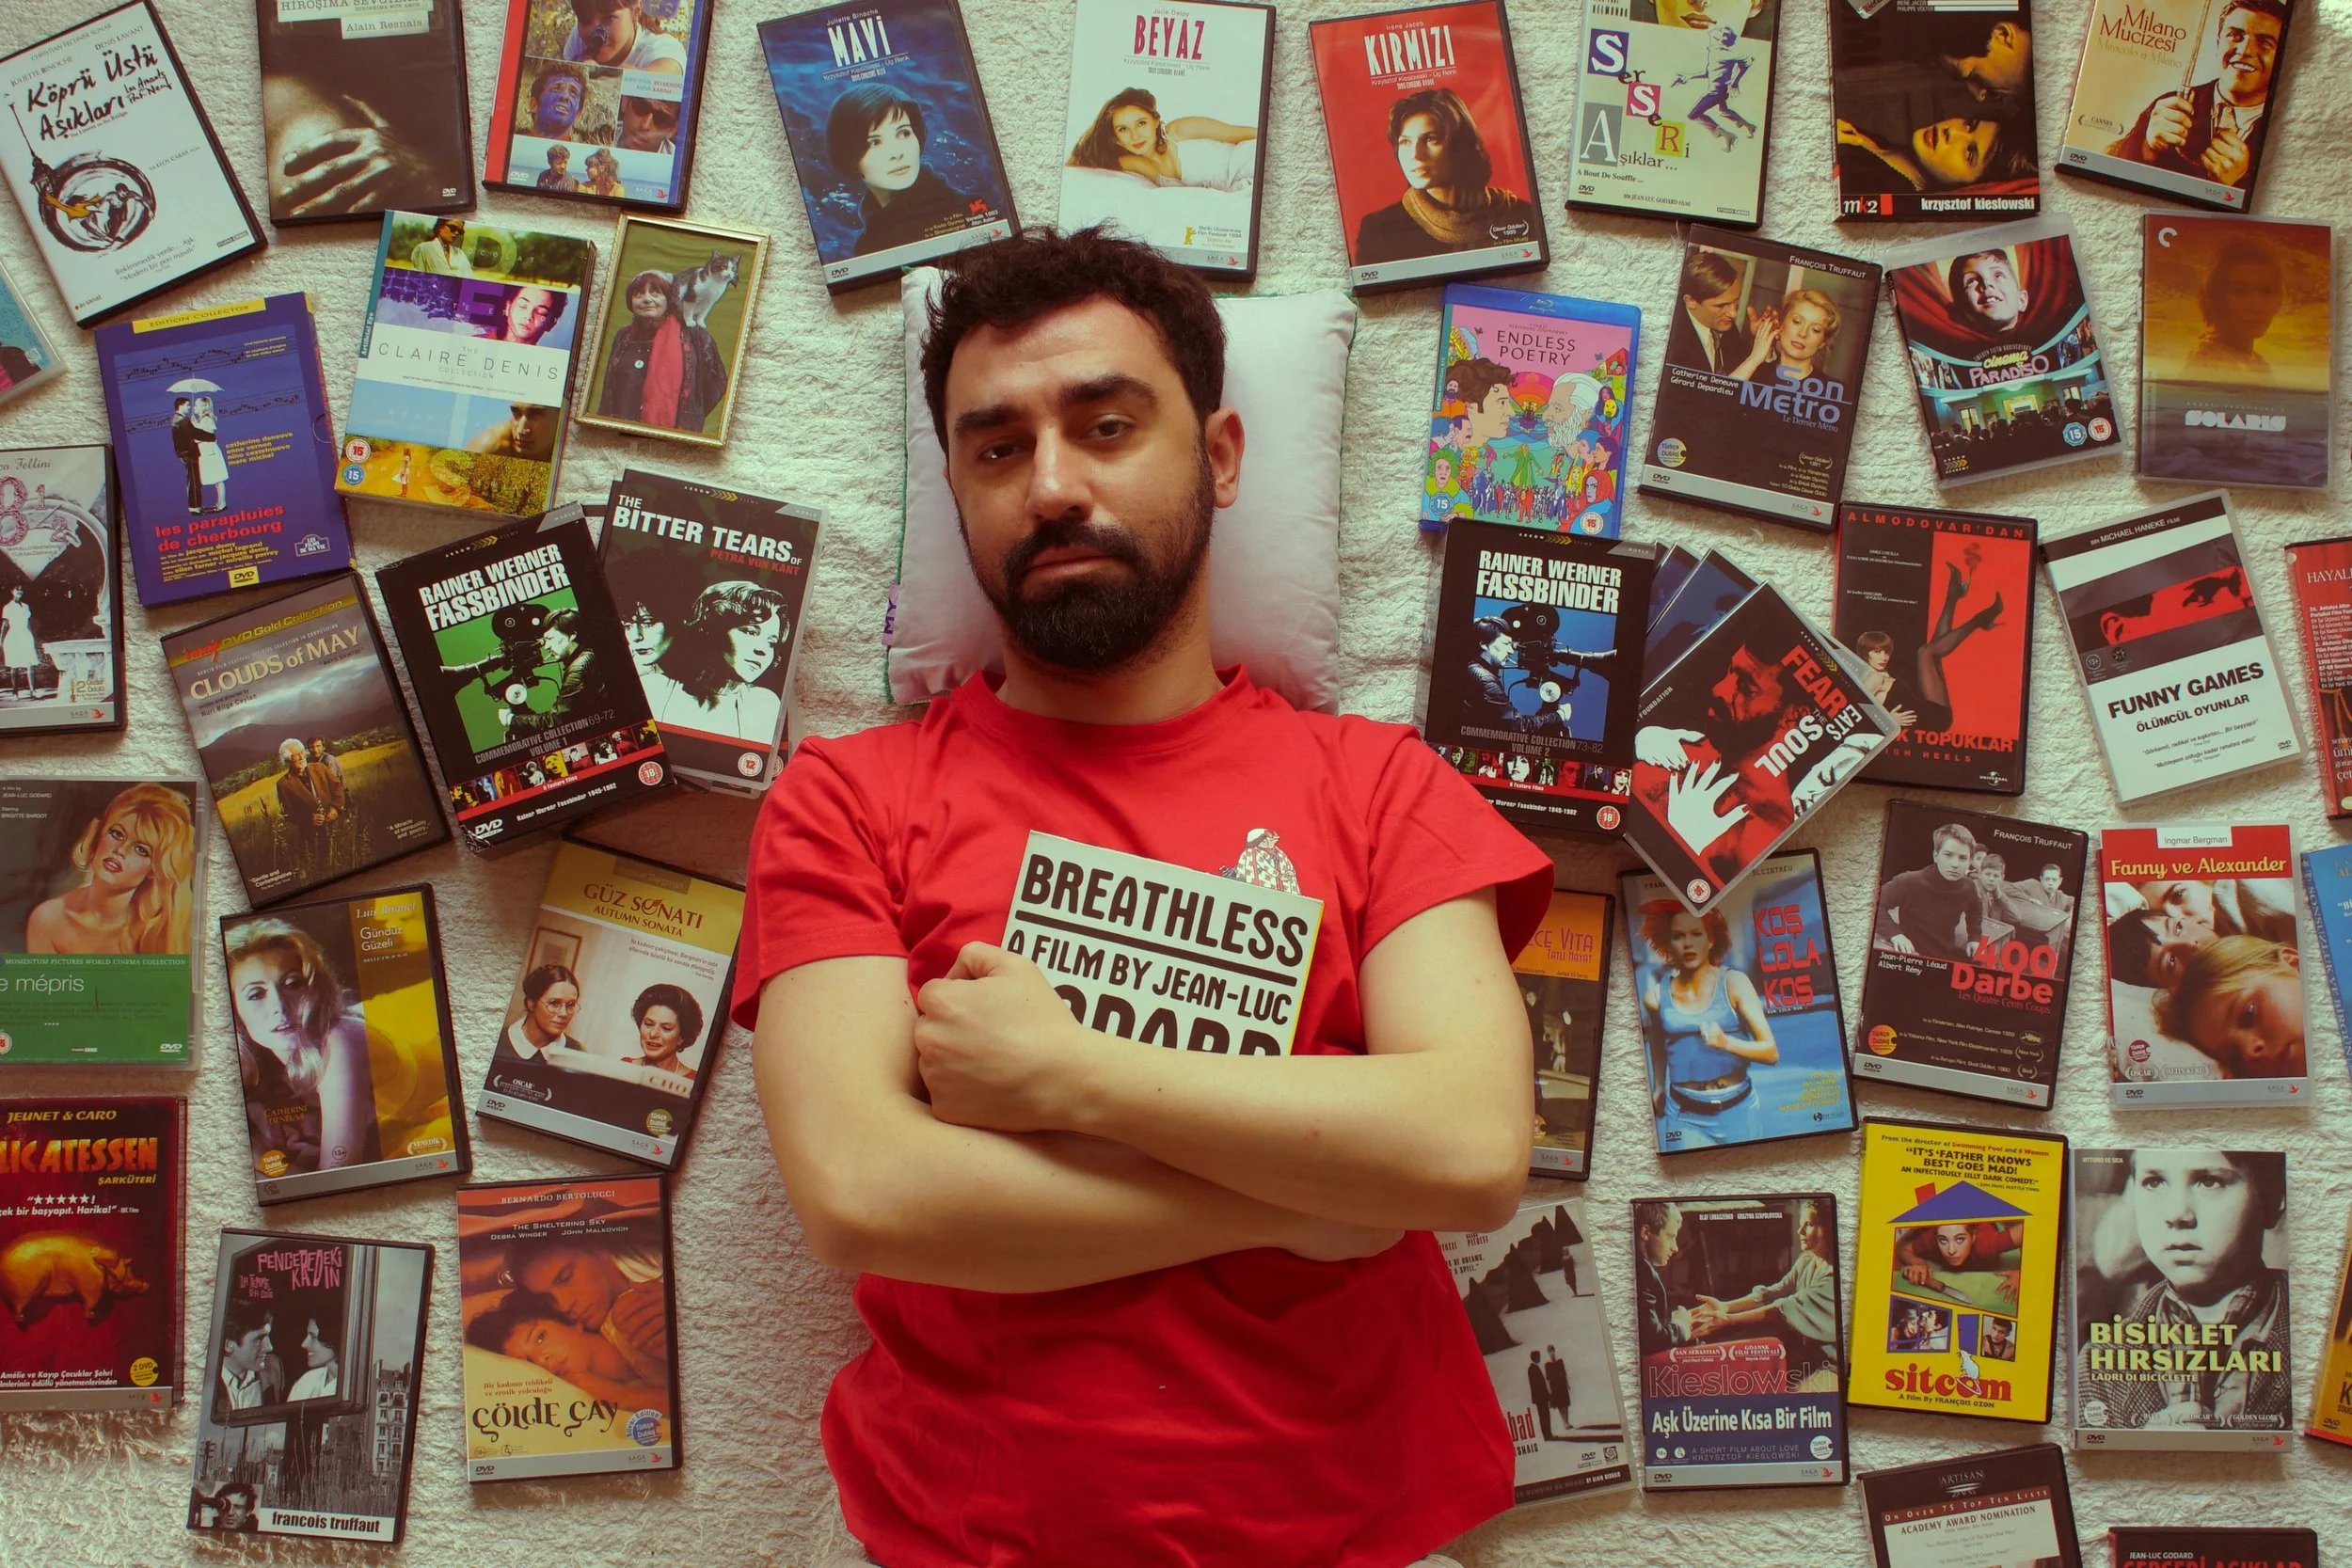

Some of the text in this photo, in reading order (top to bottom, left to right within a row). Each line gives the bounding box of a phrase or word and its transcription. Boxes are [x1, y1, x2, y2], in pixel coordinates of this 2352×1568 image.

[345, 18, 422, 33] Alain Resnais
[826, 14, 850, 26] Juliette
[2122, 5, 2187, 41] Milano
[1134, 15, 1205, 61] BEYAZ
[2099, 14, 2176, 53] Mucizesi
[1364, 24, 1455, 76] KIRMIZI
[27, 44, 158, 118] Köprü Üstü
[40, 96, 124, 140] Aşıkları
[1844, 197, 2034, 214] mk2 krzysztof kieslowski
[1788, 255, 1867, 279] FRANÇOIS TRUFFAUT
[1497, 329, 1577, 352] ENDLESS
[378, 342, 559, 381] CLAIRE DENIS
[1500, 345, 1571, 367] POETRY
[1982, 351, 2029, 370] cinema
[438, 367, 494, 380] COLLECTION
[1671, 368, 1739, 388] Catherine Deneuve
[1969, 355, 2049, 388] PARADISO
[1670, 375, 1734, 397] Gérard Depardieu
[1774, 365, 1845, 403] Son
[1740, 380, 1841, 424] Metro
[2185, 409, 2287, 433] SOLARIS
[225, 436, 260, 449] catherine
[15, 458, 53, 471] Fellini
[618, 494, 643, 509] THE
[155, 504, 286, 538] les parapluies
[1848, 511, 2024, 538] ALMODOVAR'DAN
[2100, 519, 2166, 544] MICHAEL HANEKE
[158, 520, 283, 552] de cherbourg
[612, 505, 803, 565] BITTER TEARS OF
[710, 548, 800, 576] PETRA VON KANT
[1479, 549, 1622, 588] RAINER WERNER
[419, 543, 563, 607] RAINER WERNER
[424, 562, 571, 632] FASSBINDER
[1476, 570, 1620, 613] FASSBINDER
[283, 600, 343, 626] Collection
[190, 626, 360, 701] CLOUDS of MAY
[1780, 643, 1849, 718] FEAR
[2107, 661, 2265, 720] FUNNY GAMES
[1804, 707, 1829, 728] THE
[1823, 704, 1864, 742] EATS
[2136, 693, 2250, 733] ÖLÜMCÜL OYUNLAR
[474, 707, 616, 765] COMMEMORATIVE COLLECTION 69-72
[1460, 725, 1604, 753] COMMEMORATIVE COLLECTION 73-82
[1754, 715, 1825, 779] SOUL
[1915, 728, 2014, 752] TOPUKLAR
[529, 741, 559, 759] VOLUME
[1511, 742, 1543, 756] VOLUME
[1922, 751, 1972, 763] HEELS
[475, 818, 503, 835] DVD
[1994, 829, 2073, 850] FRANÇOIS TRUFFAUT
[2164, 835, 2228, 847] Ingmar Bergman
[2110, 857, 2287, 879] Fanny ve Alexander
[583, 882, 704, 930] GÜZ SONATI
[1021, 853, 1309, 968] BREATHLESS
[359, 925, 403, 940] Gündüz
[592, 905, 683, 938] AUTUMN SONATA
[1752, 904, 1804, 940] KOŞ
[361, 940, 393, 952] Güzeli
[1560, 927, 1594, 952] VITA
[1758, 938, 1822, 973] LOLA
[1879, 951, 1947, 970] Jean-Pierre Léaud
[1973, 934, 2057, 978] 400
[1007, 929, 1025, 955] A
[1032, 934, 1105, 981] FILM
[1108, 952, 1153, 990] BY
[1152, 965, 1293, 1025] JEAN-LUC
[1877, 961, 1922, 976] Albert Rémy
[16, 974, 85, 995] mépris
[1763, 974, 1814, 1009] KOŞ
[1950, 961, 2054, 1004] Darbe
[1973, 992, 1999, 1006] Quatre
[7, 1110, 117, 1124] JEUNET & CARO
[1882, 1134, 1986, 1151] From director Swimming
[1956, 1159, 2018, 1176] GOES MAD!
[1987, 1153, 2032, 1166] KNOWS
[98, 1174, 156, 1185] ŞARKÜTERİ
[1913, 1167, 1962, 1179] INFECTIOUSLY
[1982, 1174, 2003, 1182] DARK
[501, 1190, 615, 1205] BERNARDO BERTOLUCCI
[532, 1219, 586, 1230] SHELTERING
[586, 1226, 628, 1235] MALKOVICH
[291, 1268, 341, 1291] KADIN
[2090, 1314, 2237, 1346] BİSİKLET
[2091, 1348, 2281, 1372] HIRSIZLARI
[61, 1370, 93, 1380] Çocuklar
[1649, 1360, 1835, 1398] Kieslowski
[1885, 1362, 2012, 1402] sitcom
[2091, 1372, 2198, 1382] LADRI BICICLETTE
[1934, 1396, 1972, 1407] FRANÇOIS
[1652, 1405, 1832, 1438] Aşk Üzerine Kısa Bir Film
[1939, 1469, 1984, 1486] ARTISAN
[272, 1511, 380, 1533] francois truffaut
[1900, 1504, 2036, 1535] ACADEMY NOMINATION
